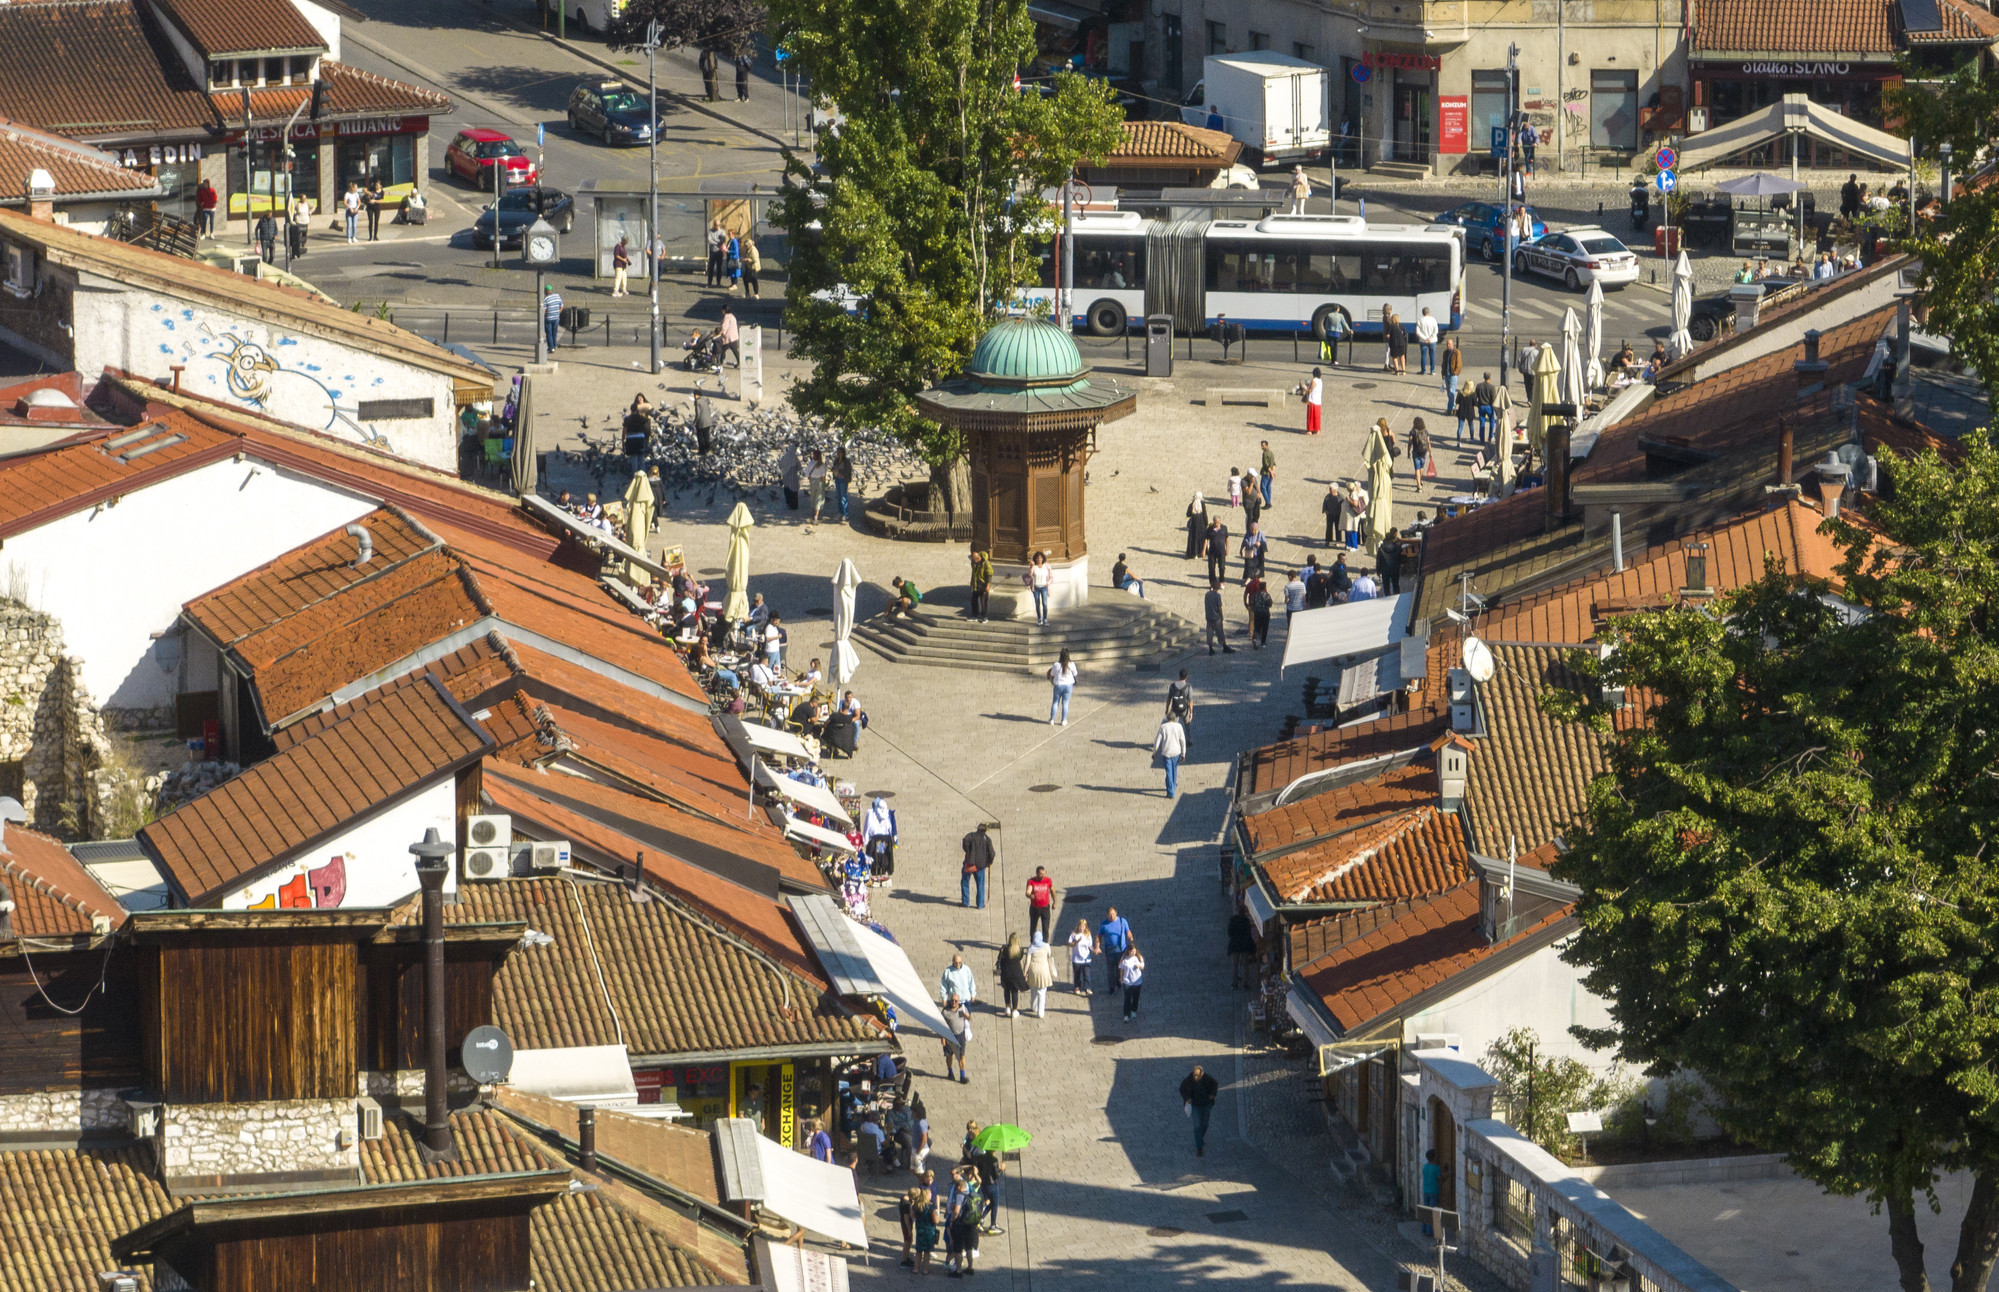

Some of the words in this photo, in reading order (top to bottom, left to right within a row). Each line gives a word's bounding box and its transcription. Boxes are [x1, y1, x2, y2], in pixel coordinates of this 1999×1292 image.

[1363, 50, 1441, 72] KONZUM
[1795, 62, 1850, 74] SLANO
[1495, 129, 1504, 145] P
[149, 142, 202, 165] EDIN
